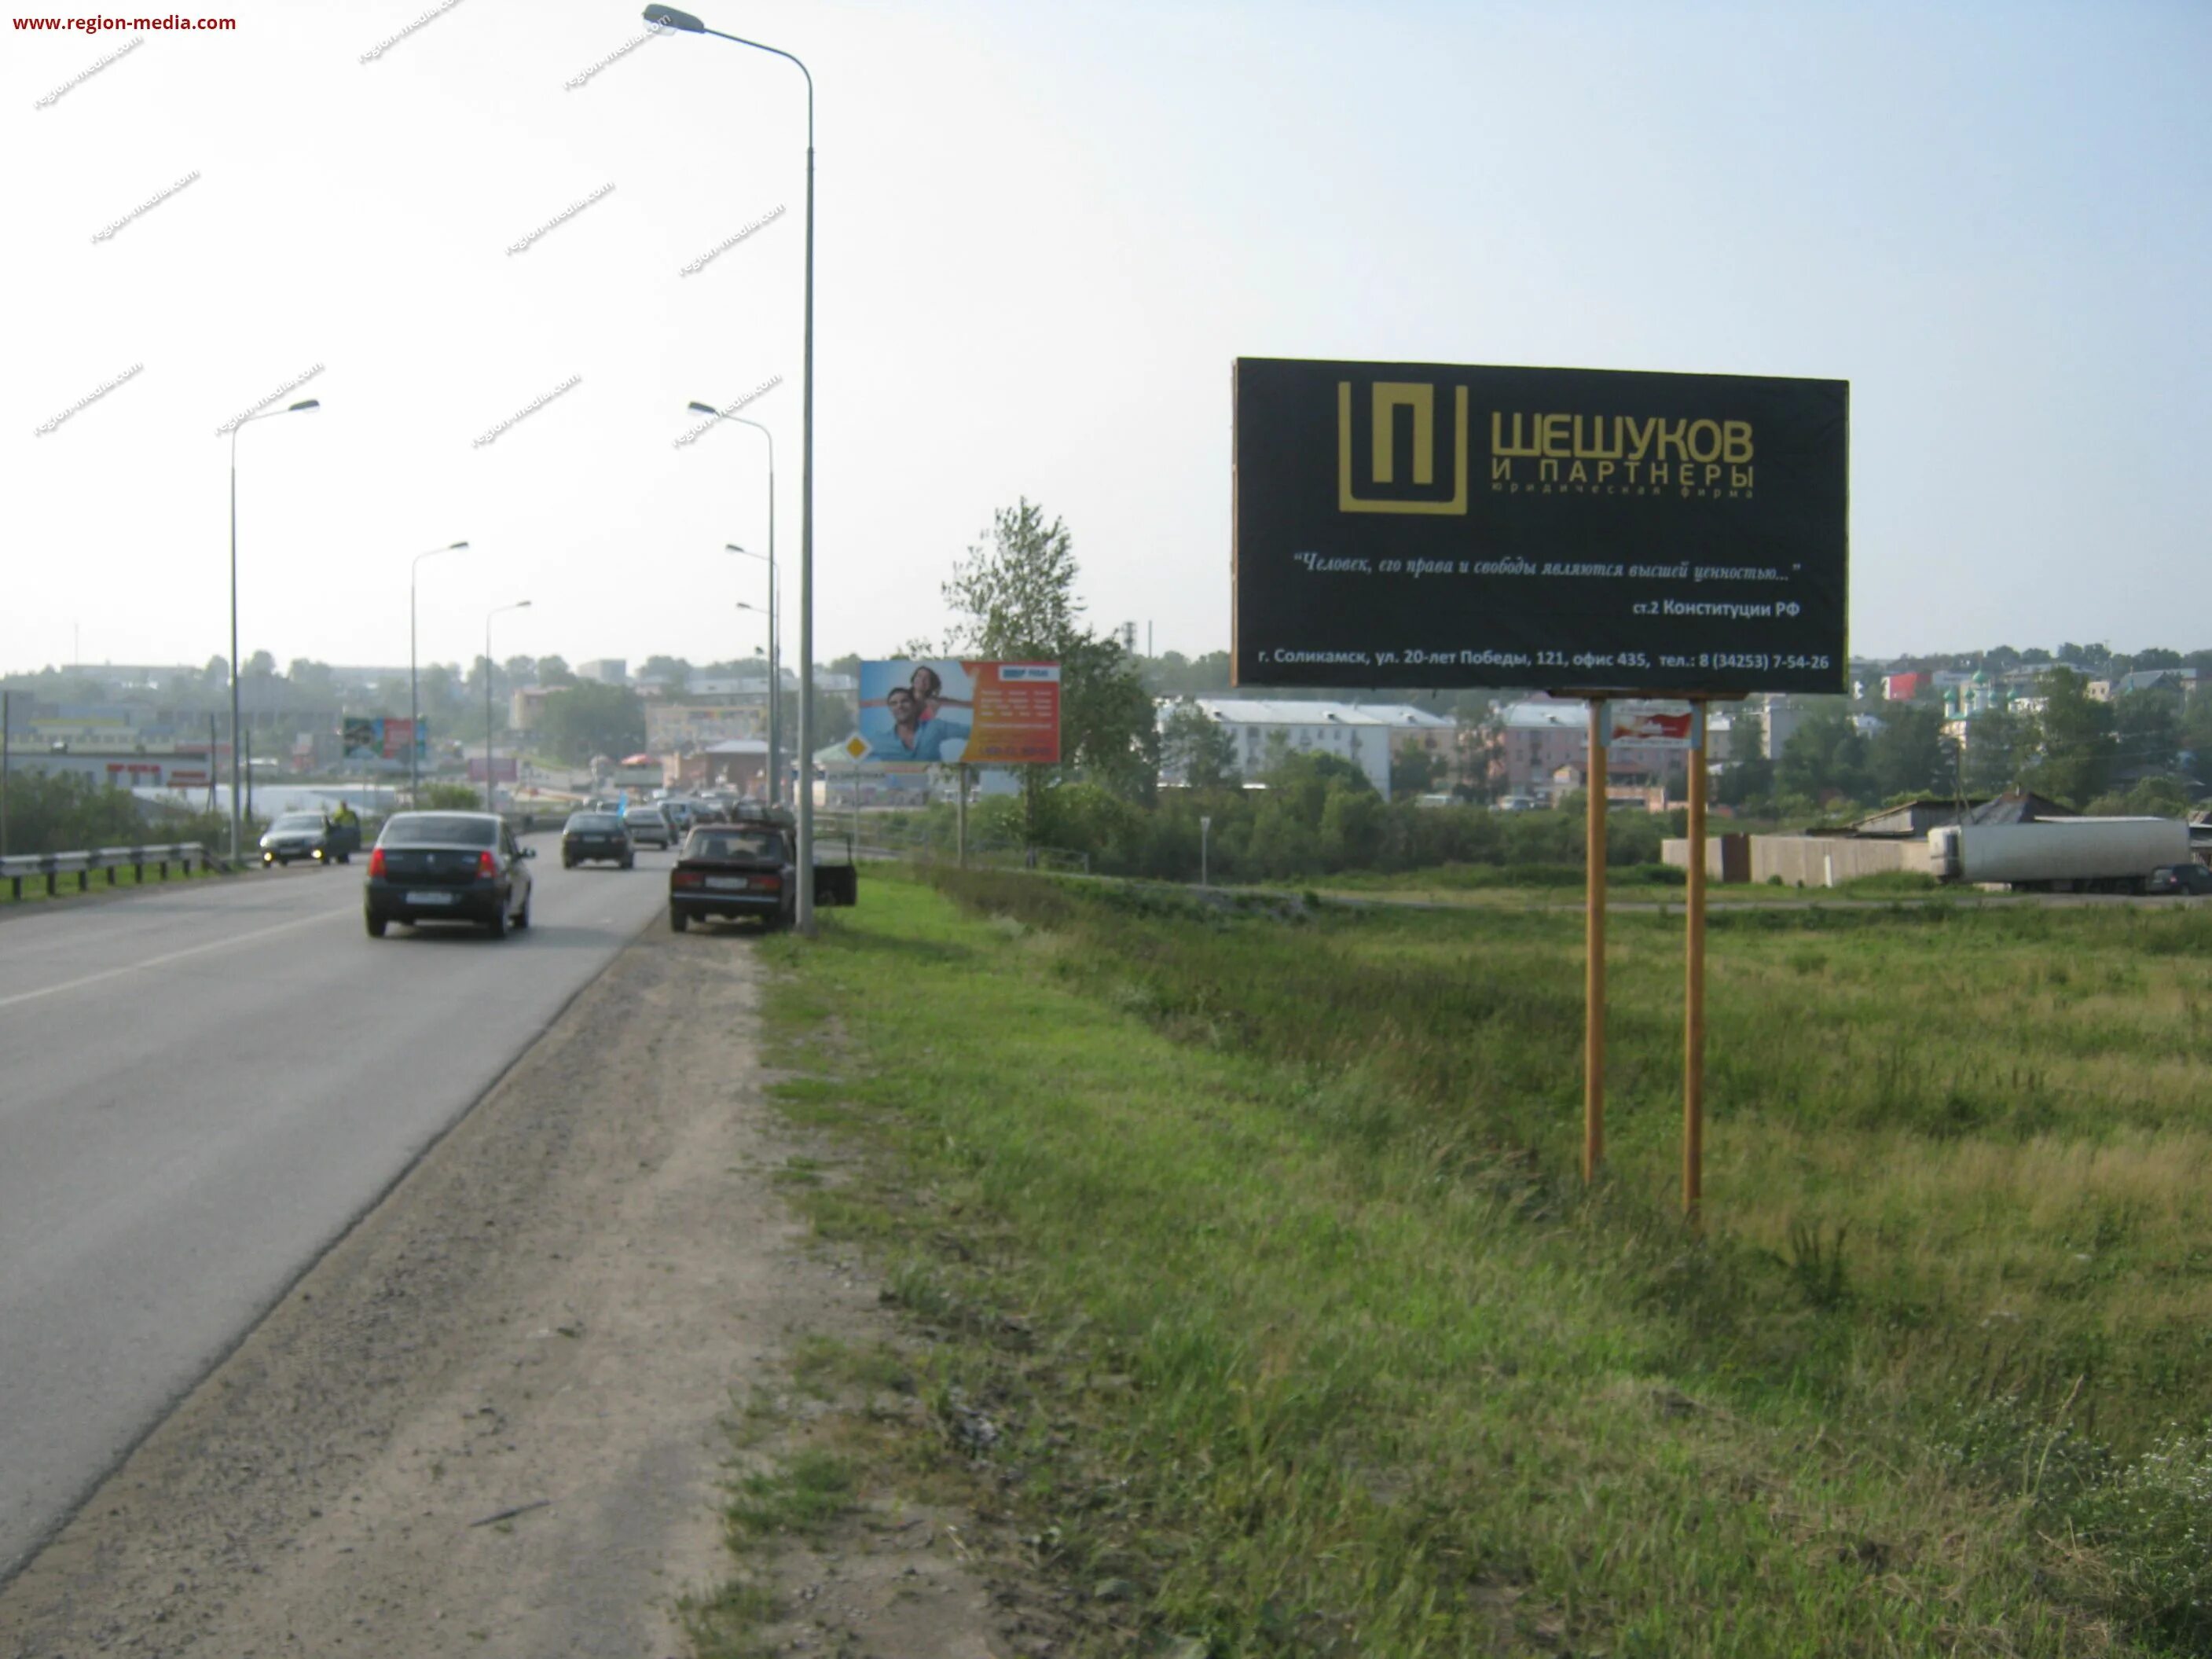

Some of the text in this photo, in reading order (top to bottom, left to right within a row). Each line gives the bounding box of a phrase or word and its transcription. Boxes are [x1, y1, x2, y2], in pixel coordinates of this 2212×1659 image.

[1491, 411, 1754, 464] ШЕШУКОВ
[1492, 457, 1754, 488] И ПАРТНЕРЫ
[1680, 486, 1754, 499] фирма
[1378, 559, 1402, 574] его
[1406, 559, 1454, 578] права
[1458, 560, 1468, 574] и
[1473, 555, 1537, 576] свободы
[1541, 562, 1624, 577] являются
[1628, 560, 1690, 578] высшей
[1663, 599, 1771, 619] Конституции
[1774, 600, 1800, 617] РФ
[1258, 648, 1829, 671] г. Соликамск, ул. 20-лет Победы, 121, офис 435, тел.: 8 (34253) 7-54-26
